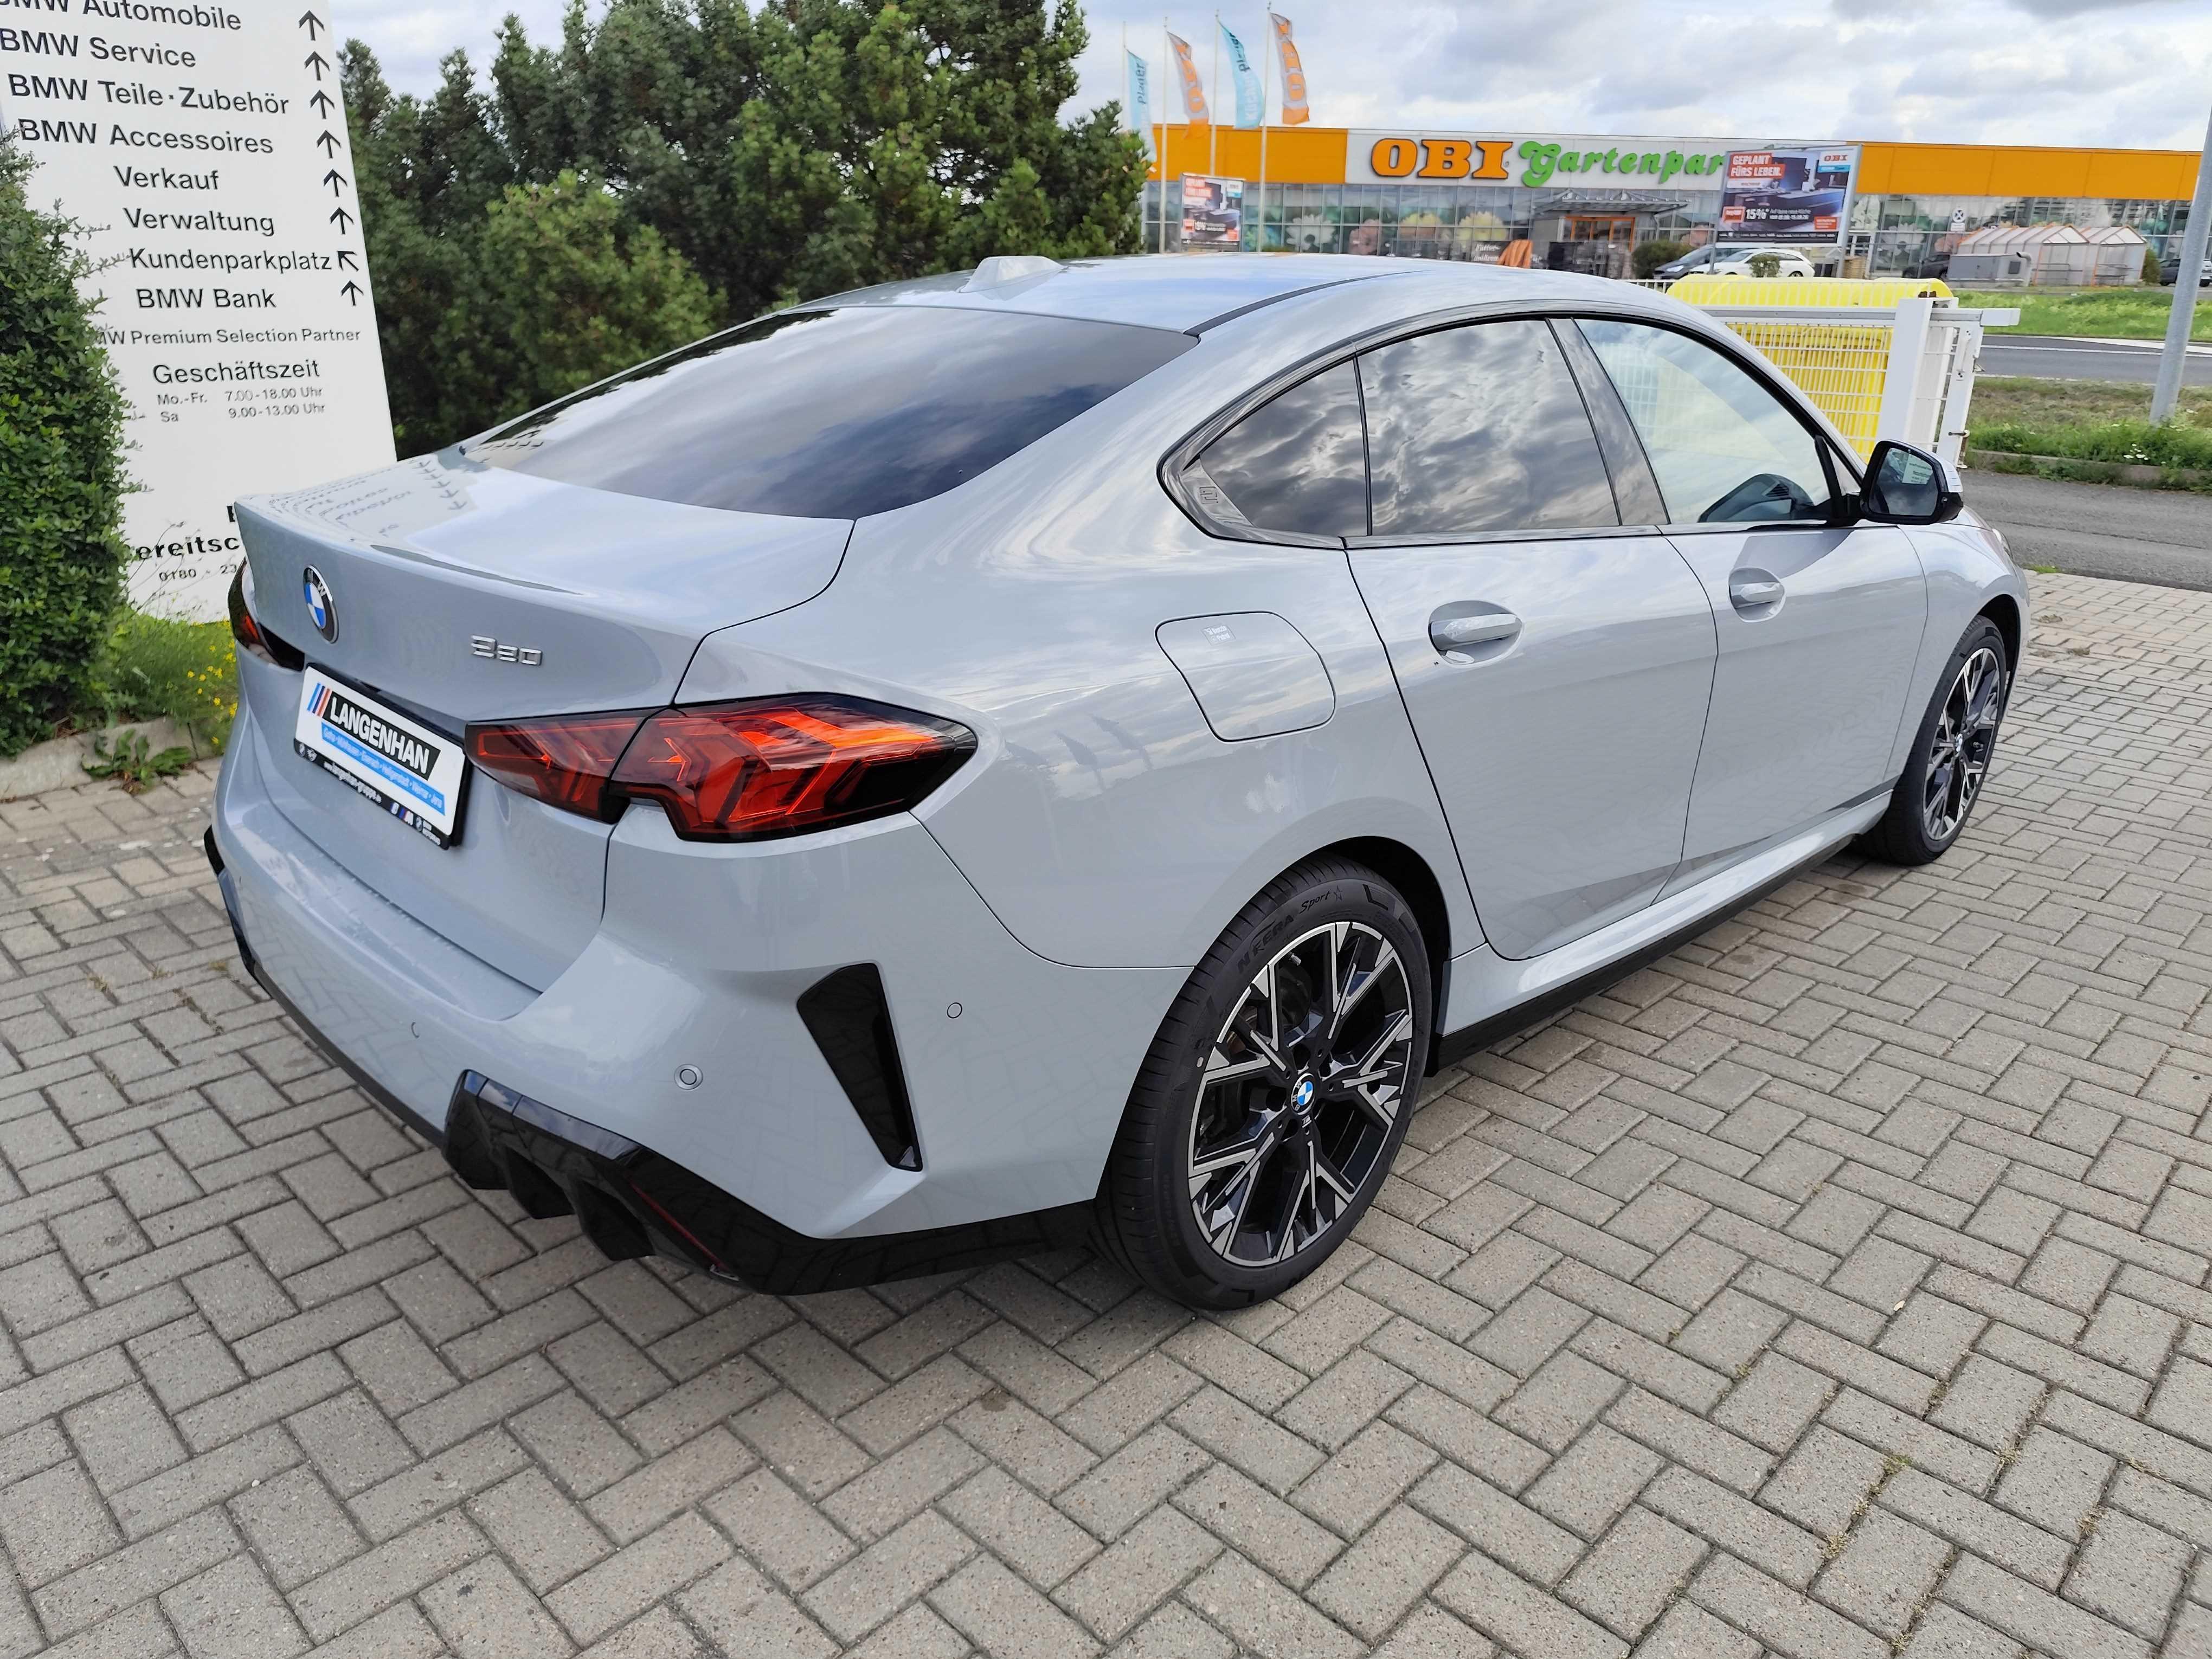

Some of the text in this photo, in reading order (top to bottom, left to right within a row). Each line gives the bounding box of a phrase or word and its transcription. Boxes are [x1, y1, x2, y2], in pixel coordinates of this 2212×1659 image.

[83, 0, 242, 30] Automobile
[0, 28, 196, 67] BMW Service
[8, 74, 87, 100] BMW
[18, 118, 273, 153] BMW Accessoires
[1371, 138, 1725, 188] OBI Gartenpar
[1731, 166, 1753, 177] FÜRS
[1733, 155, 1771, 165] GEPLANT
[113, 165, 219, 190] Verkauf
[123, 208, 275, 236] Verwaltung
[129, 248, 332, 274] Kundenparkplatz
[136, 288, 277, 308] BMW Bank
[97, 329, 361, 344] MW Premium Selection Partner
[153, 358, 321, 384] Geschäftszeit
[300, 387, 323, 398] Uhr
[160, 411, 179, 422] Sa
[303, 403, 325, 414] Uhr
[136, 537, 240, 561] ereitsc
[330, 697, 429, 774] LANGENHAN
[1299, 890, 1330, 914] Sport
[1292, 1081, 1302, 1111] BMW
